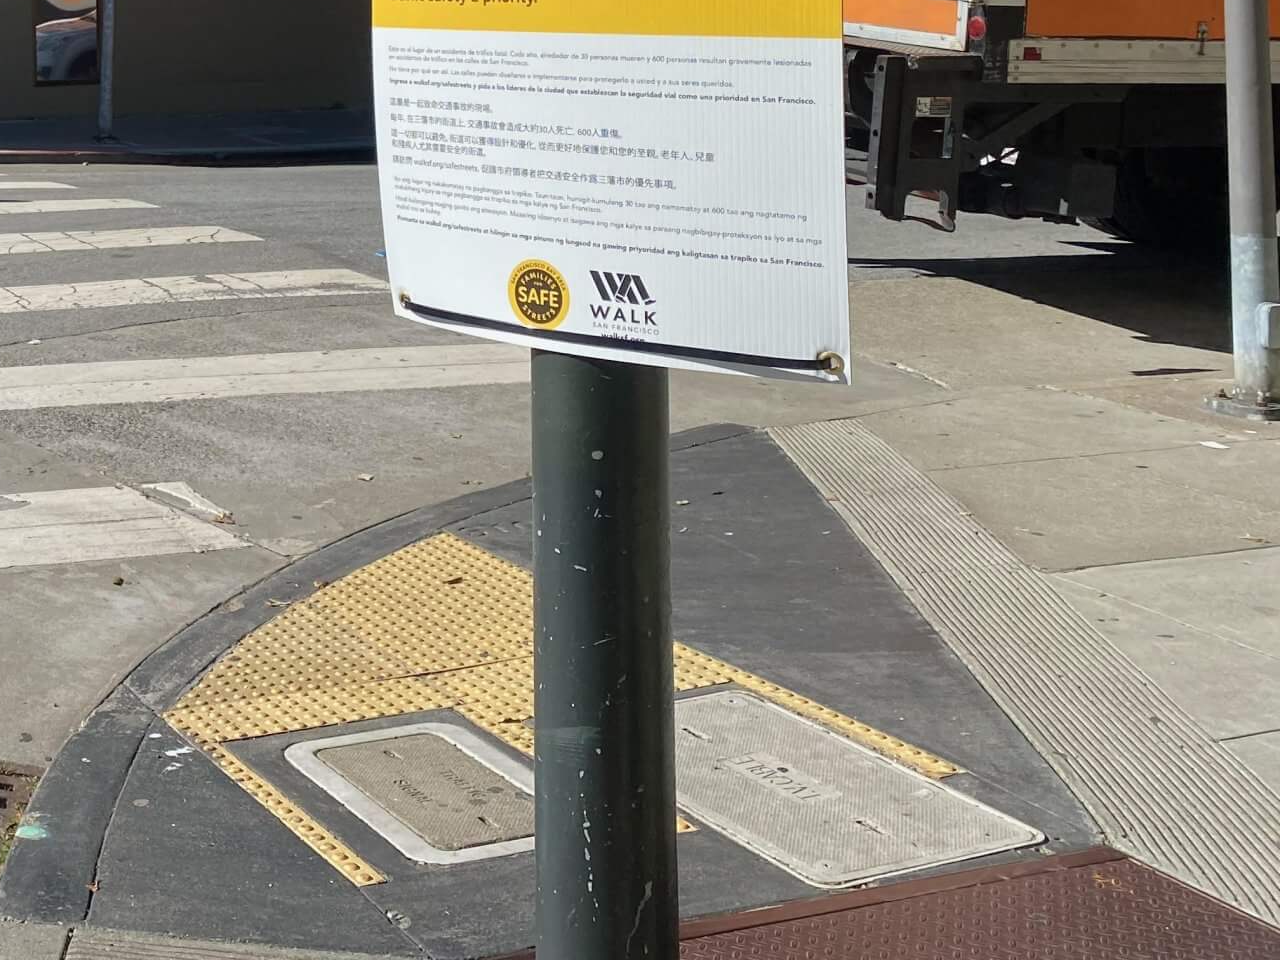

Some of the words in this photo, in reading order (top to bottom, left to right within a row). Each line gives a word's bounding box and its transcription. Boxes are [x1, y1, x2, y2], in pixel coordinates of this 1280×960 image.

[521, 272, 557, 289] FAMILIES
[518, 286, 559, 307] SAFE
[522, 305, 556, 320] STREETS
[590, 304, 657, 326] WALK
[612, 324, 660, 335] FRANCISCO
